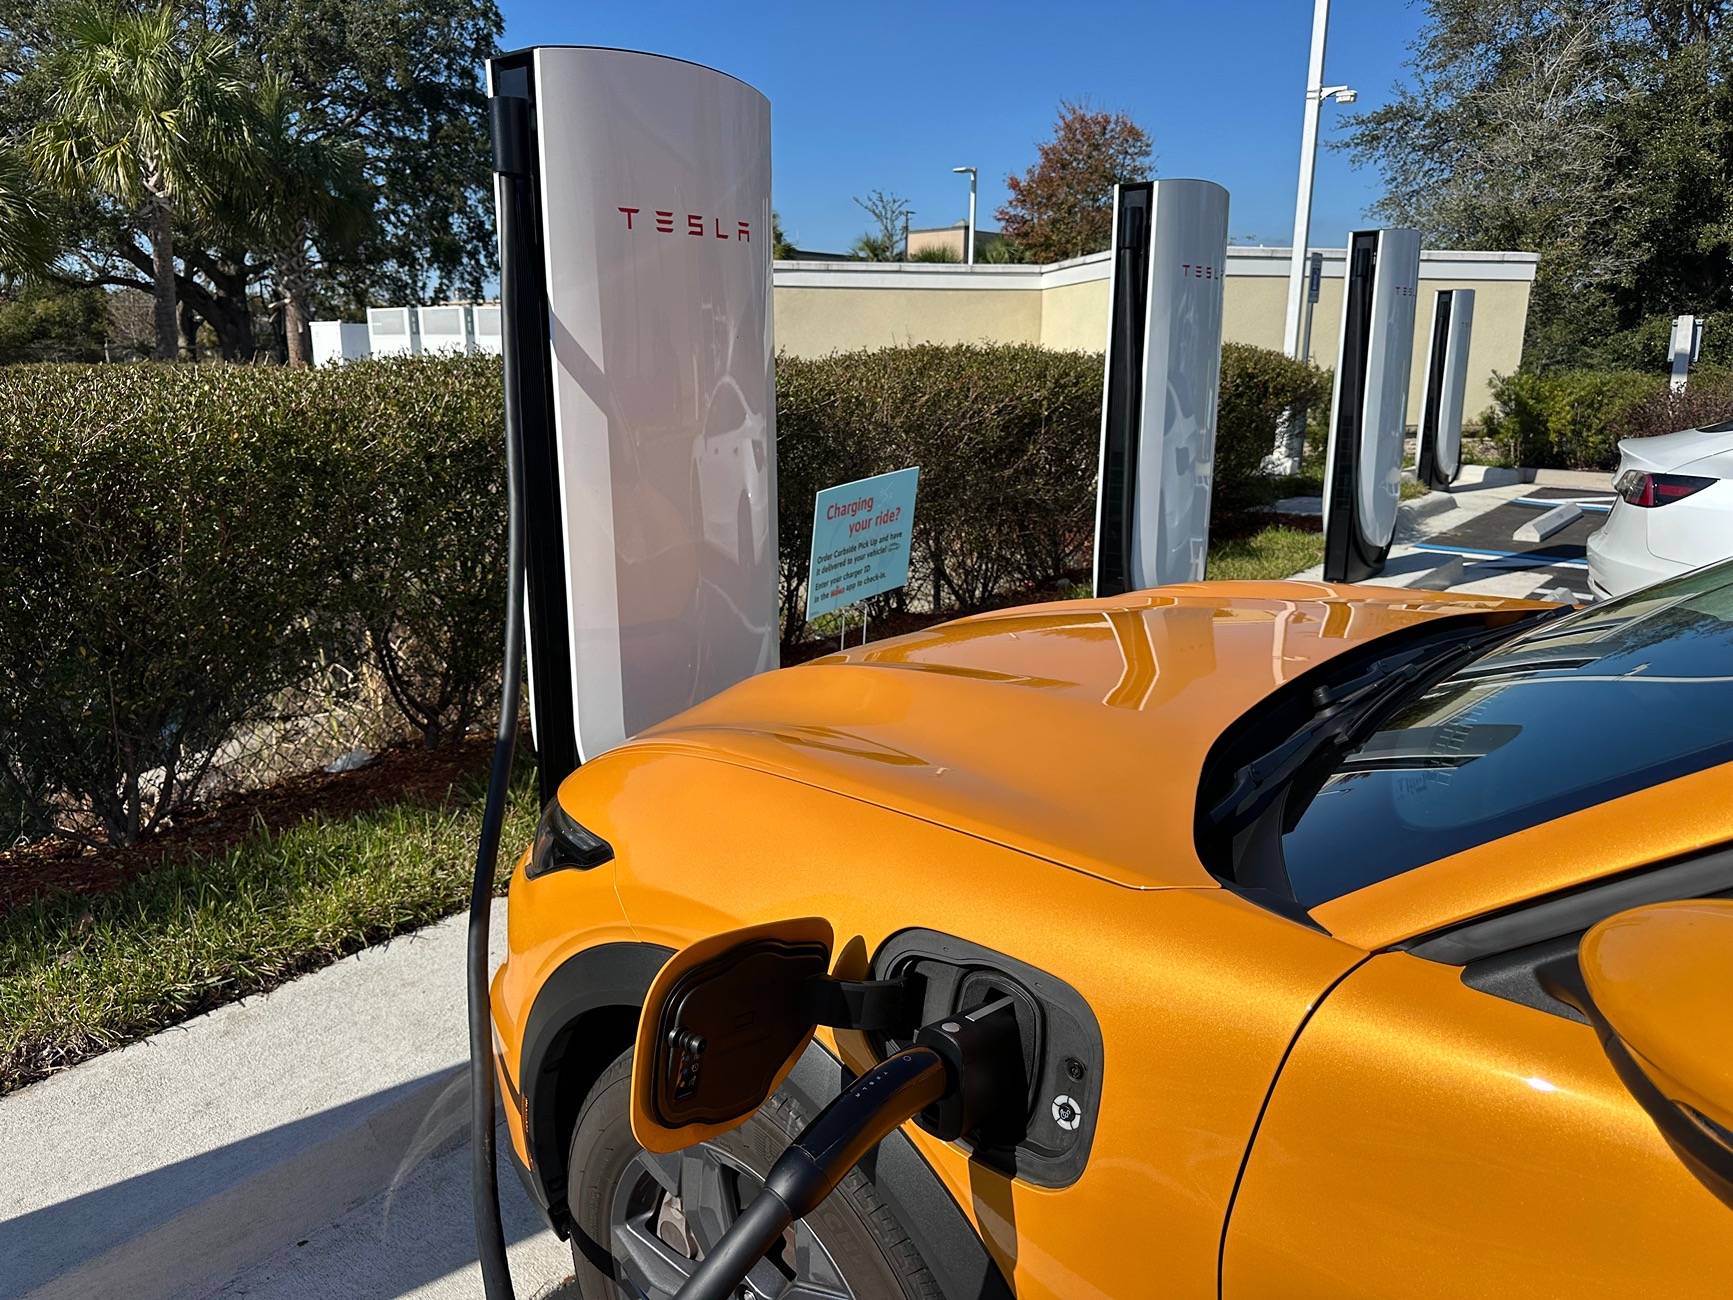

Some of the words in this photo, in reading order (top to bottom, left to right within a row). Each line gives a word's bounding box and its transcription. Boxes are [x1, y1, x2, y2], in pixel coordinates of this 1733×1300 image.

[618, 207, 750, 242] TESLA
[826, 496, 875, 521] Charging
[848, 517, 874, 538] your
[875, 507, 902, 527] ride?
[817, 553, 832, 564] Order
[833, 545, 857, 558] Curbside
[858, 540, 869, 549] Pick
[870, 538, 878, 546] Up
[879, 535, 889, 543] and
[889, 532, 903, 541] have
[821, 560, 846, 573] delivered
[847, 557, 853, 565] to
[854, 554, 866, 564] your
[815, 580, 829, 591] Enter
[830, 576, 842, 587] your
[843, 568, 863, 580] charger
[864, 564, 871, 573] ID
[820, 591, 829, 601] the
